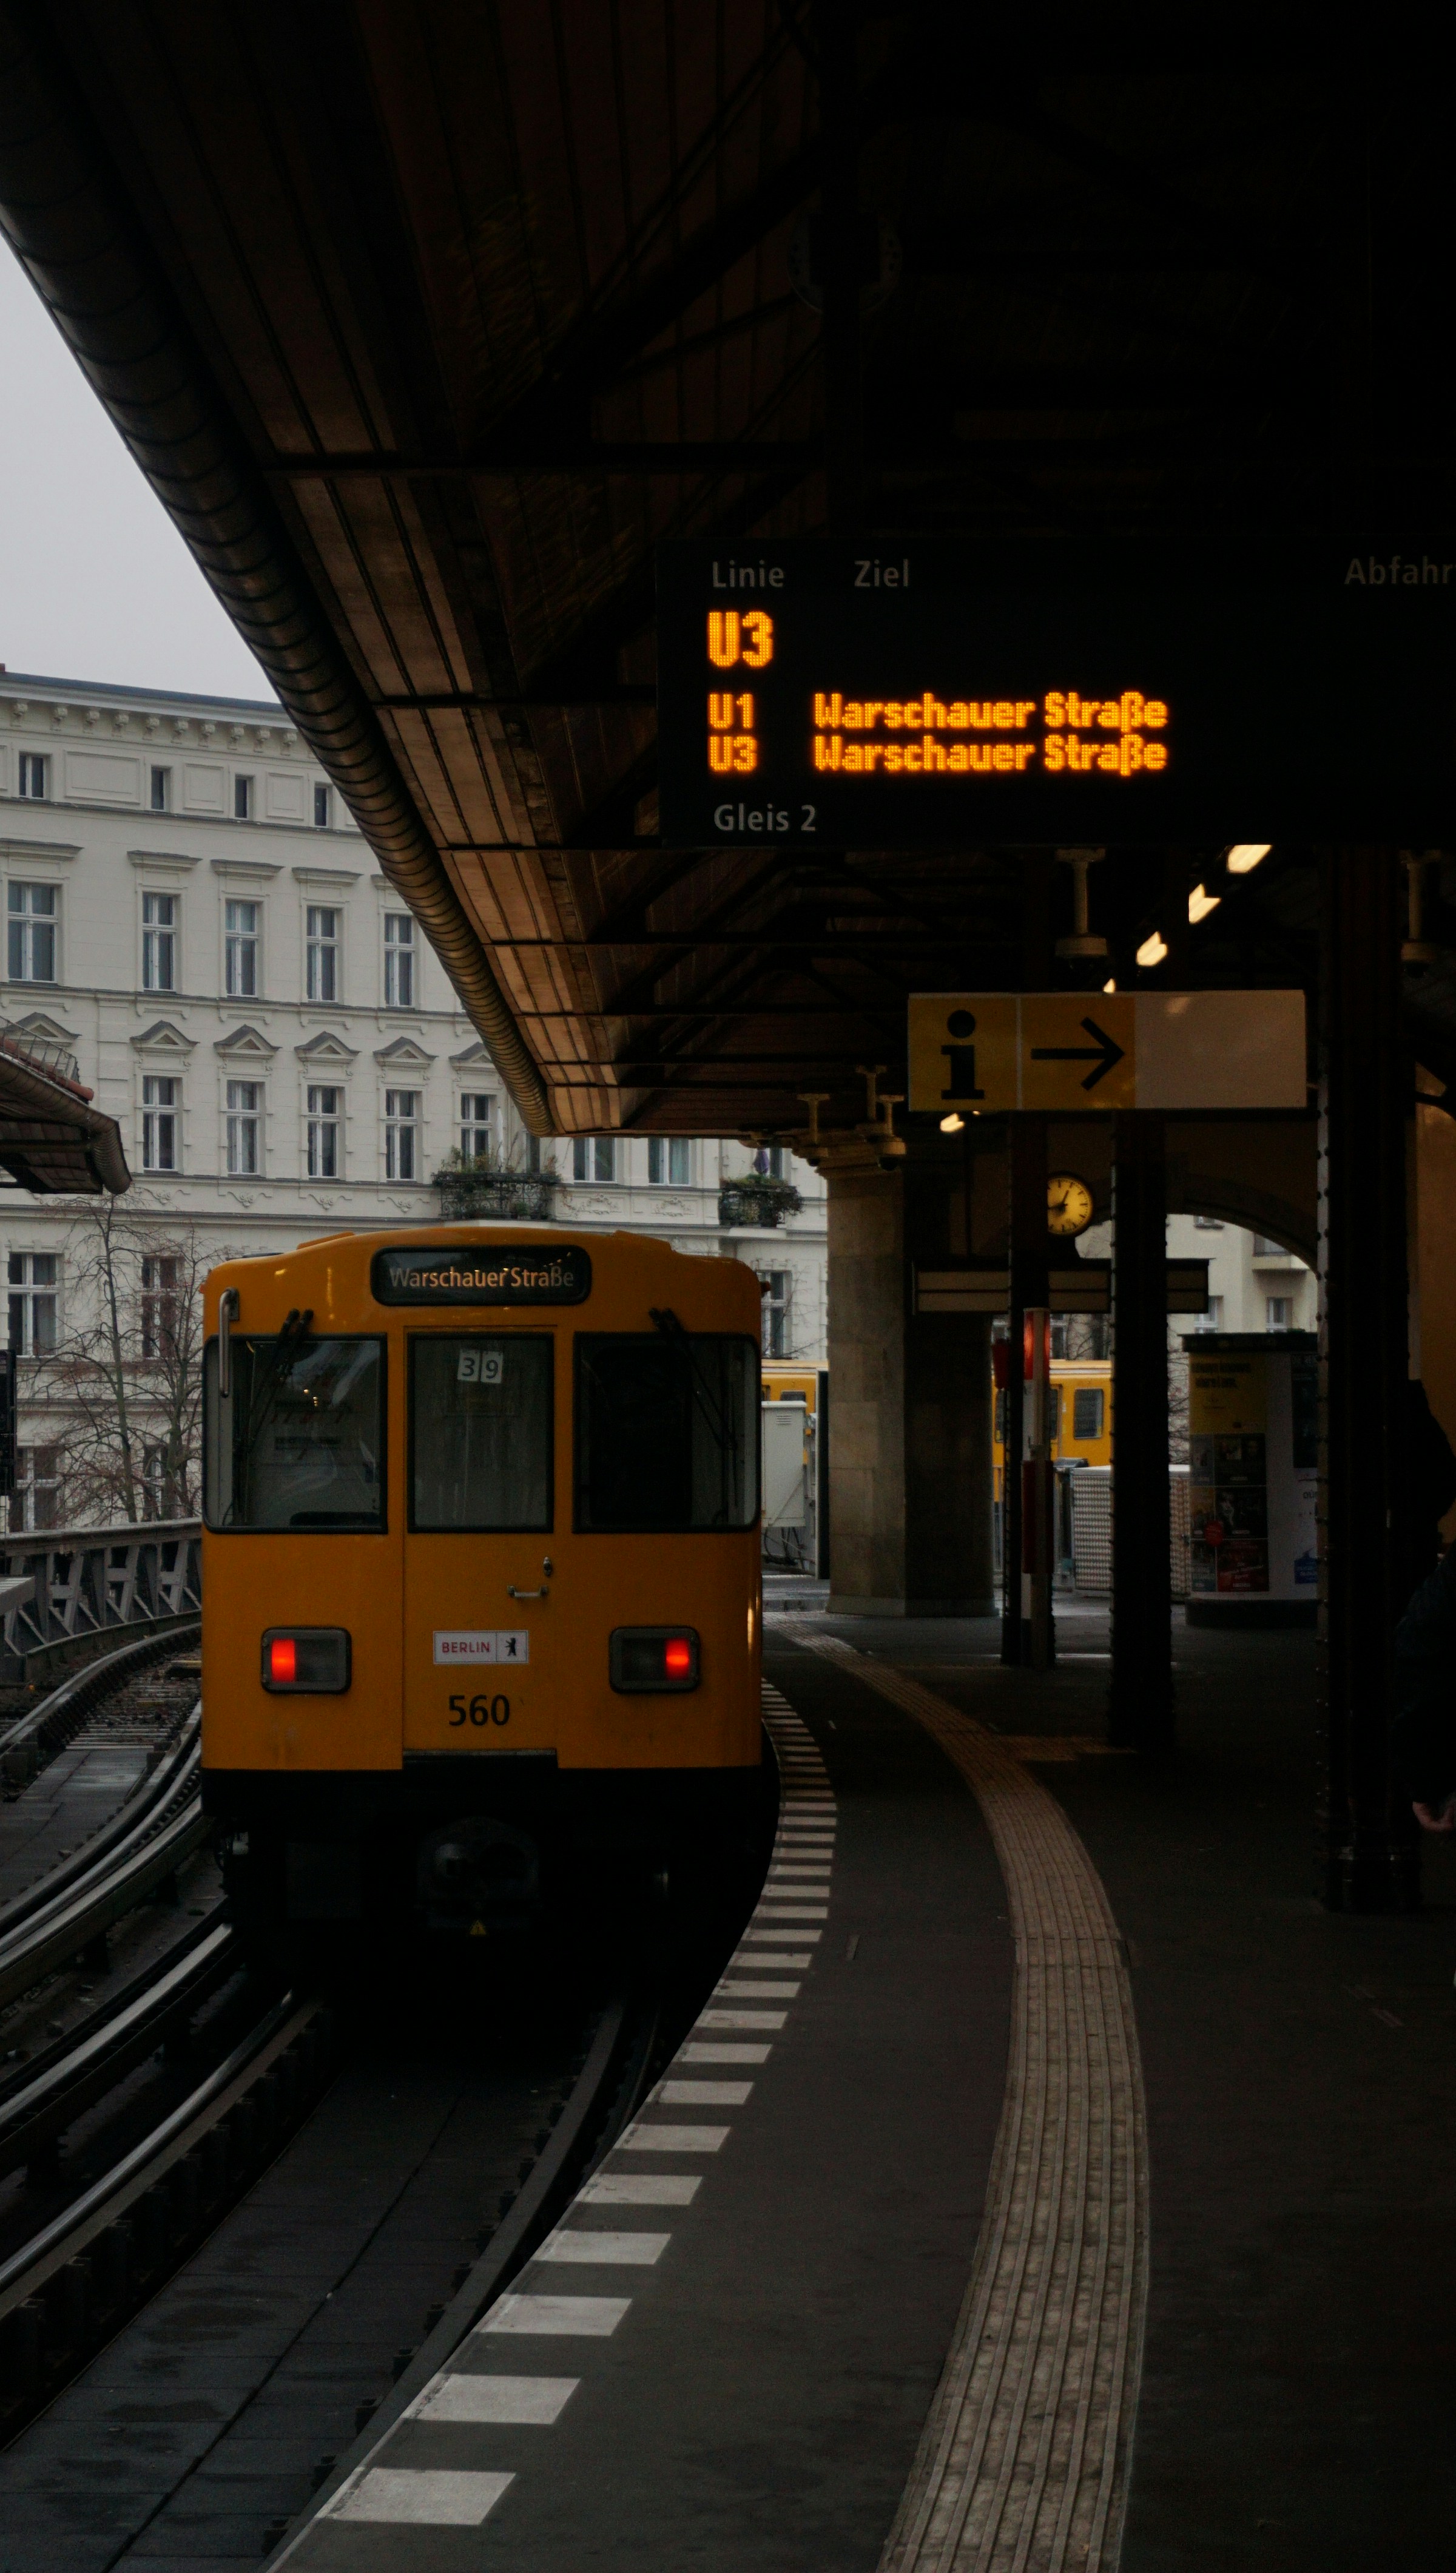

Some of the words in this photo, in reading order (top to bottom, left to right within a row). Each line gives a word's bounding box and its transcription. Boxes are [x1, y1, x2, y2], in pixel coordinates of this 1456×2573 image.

[712, 559, 784, 587] Linie
[854, 558, 910, 587] Ziel
[1344, 555, 1456, 584] Abfahr
[708, 610, 774, 668] U3
[709, 692, 753, 729] U1
[814, 692, 1036, 729] Warschauer
[1044, 691, 1168, 734] Straße
[709, 735, 758, 772] U3
[814, 735, 1036, 771] Warschauer
[1044, 734, 1168, 777] Straße
[714, 802, 789, 831] Gleis
[800, 804, 816, 831] 2
[389, 1266, 507, 1287] Warschauer
[509, 1266, 574, 1287] Straße
[442, 1642, 490, 1653] BERLIN
[449, 1694, 510, 1726] 560
